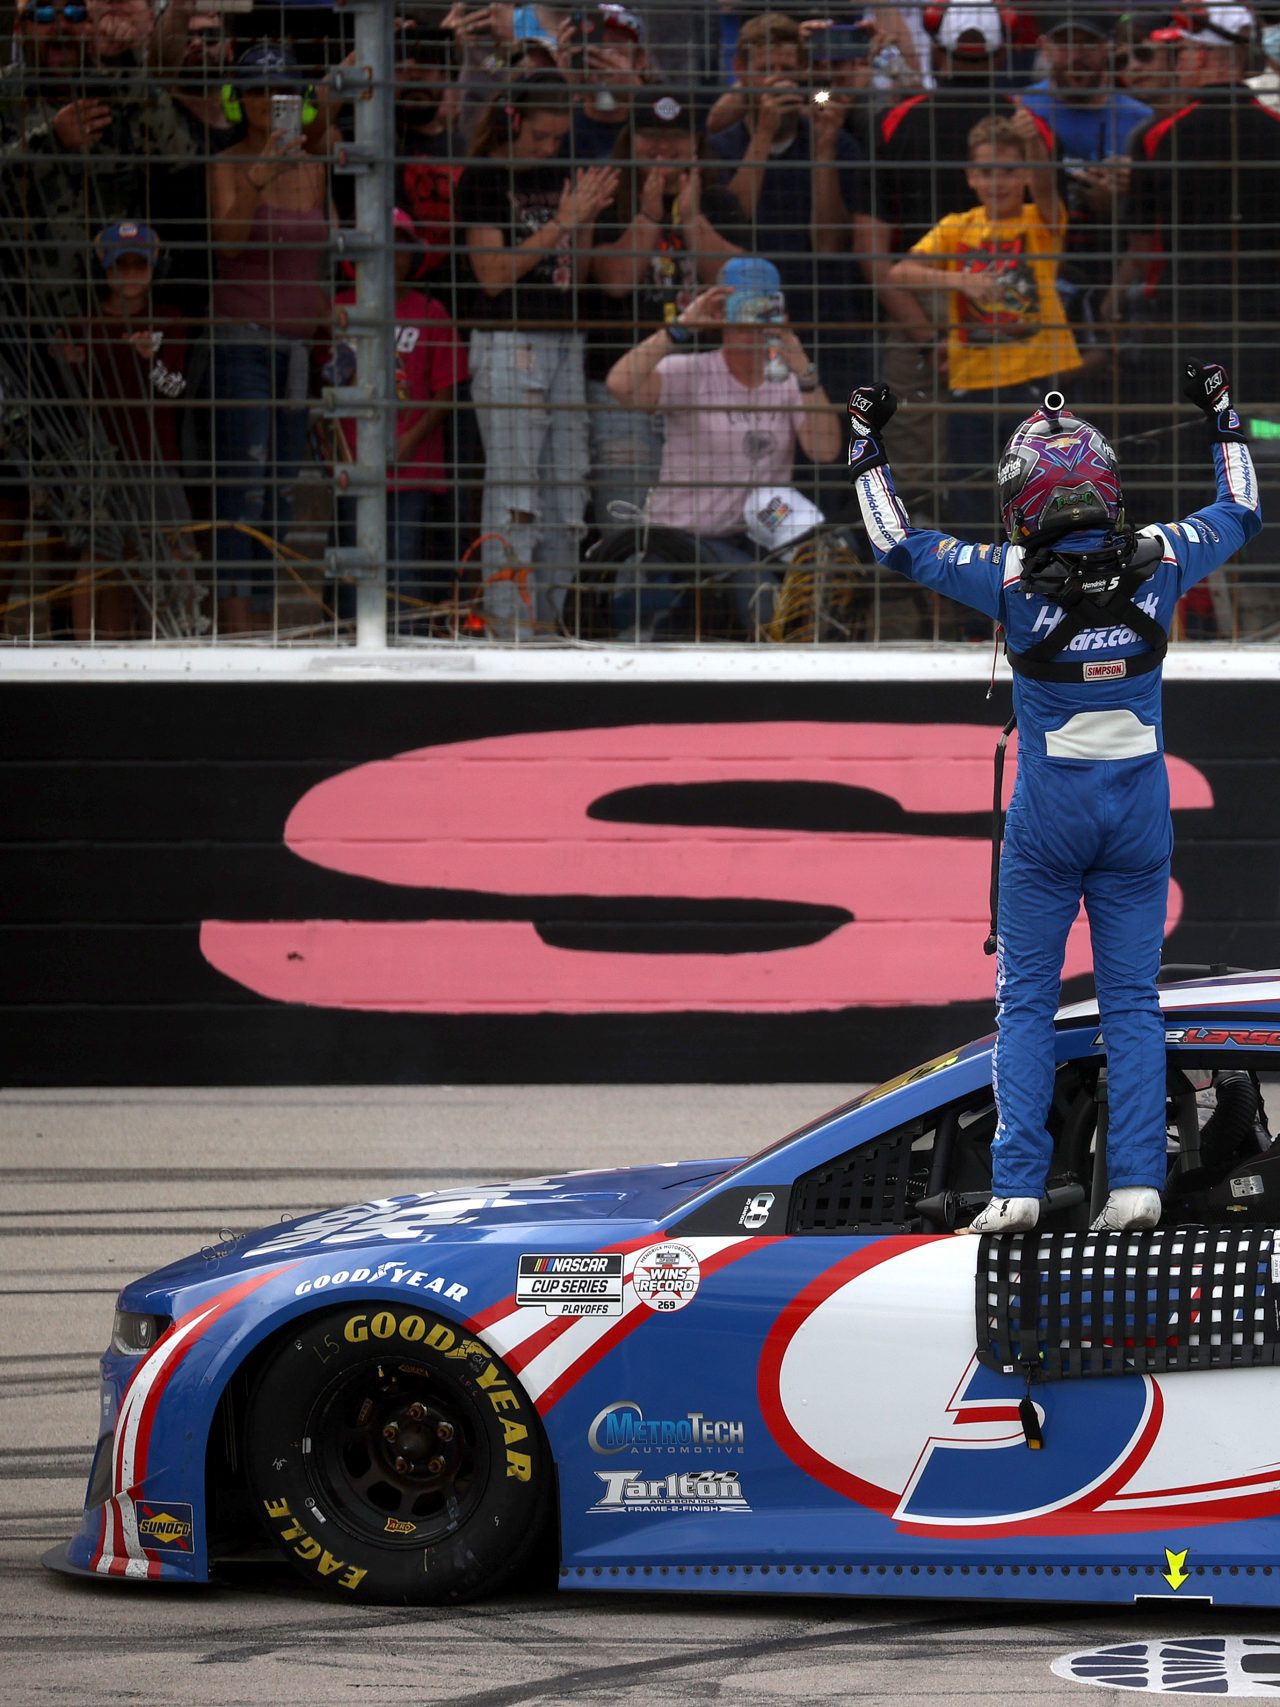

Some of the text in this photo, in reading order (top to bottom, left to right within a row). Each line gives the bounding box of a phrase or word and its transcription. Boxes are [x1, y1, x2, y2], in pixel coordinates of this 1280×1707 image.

[851, 440, 868, 461] 5
[1107, 576, 1120, 590] 5
[1087, 664, 1122, 676] SIMPSON
[744, 1192, 775, 1229] 8
[641, 1246, 663, 1263] HENDRICK
[663, 1245, 696, 1263] MOTORSPORTS
[552, 1258, 608, 1272] NASCAR
[650, 1268, 688, 1280] WINS
[531, 1279, 608, 1293] CUP SERIES
[639, 1280, 695, 1292] RECORD
[561, 1304, 608, 1314] PLAYOFFS
[658, 1300, 676, 1310] 269
[631, 1446, 744, 1454] AUTOMOTIVE
[594, 1471, 744, 1505] Tarlton
[140, 1520, 190, 1535] SUNOCO
[388, 1521, 411, 1531] AERO
[263, 1497, 368, 1590] EAGLE
